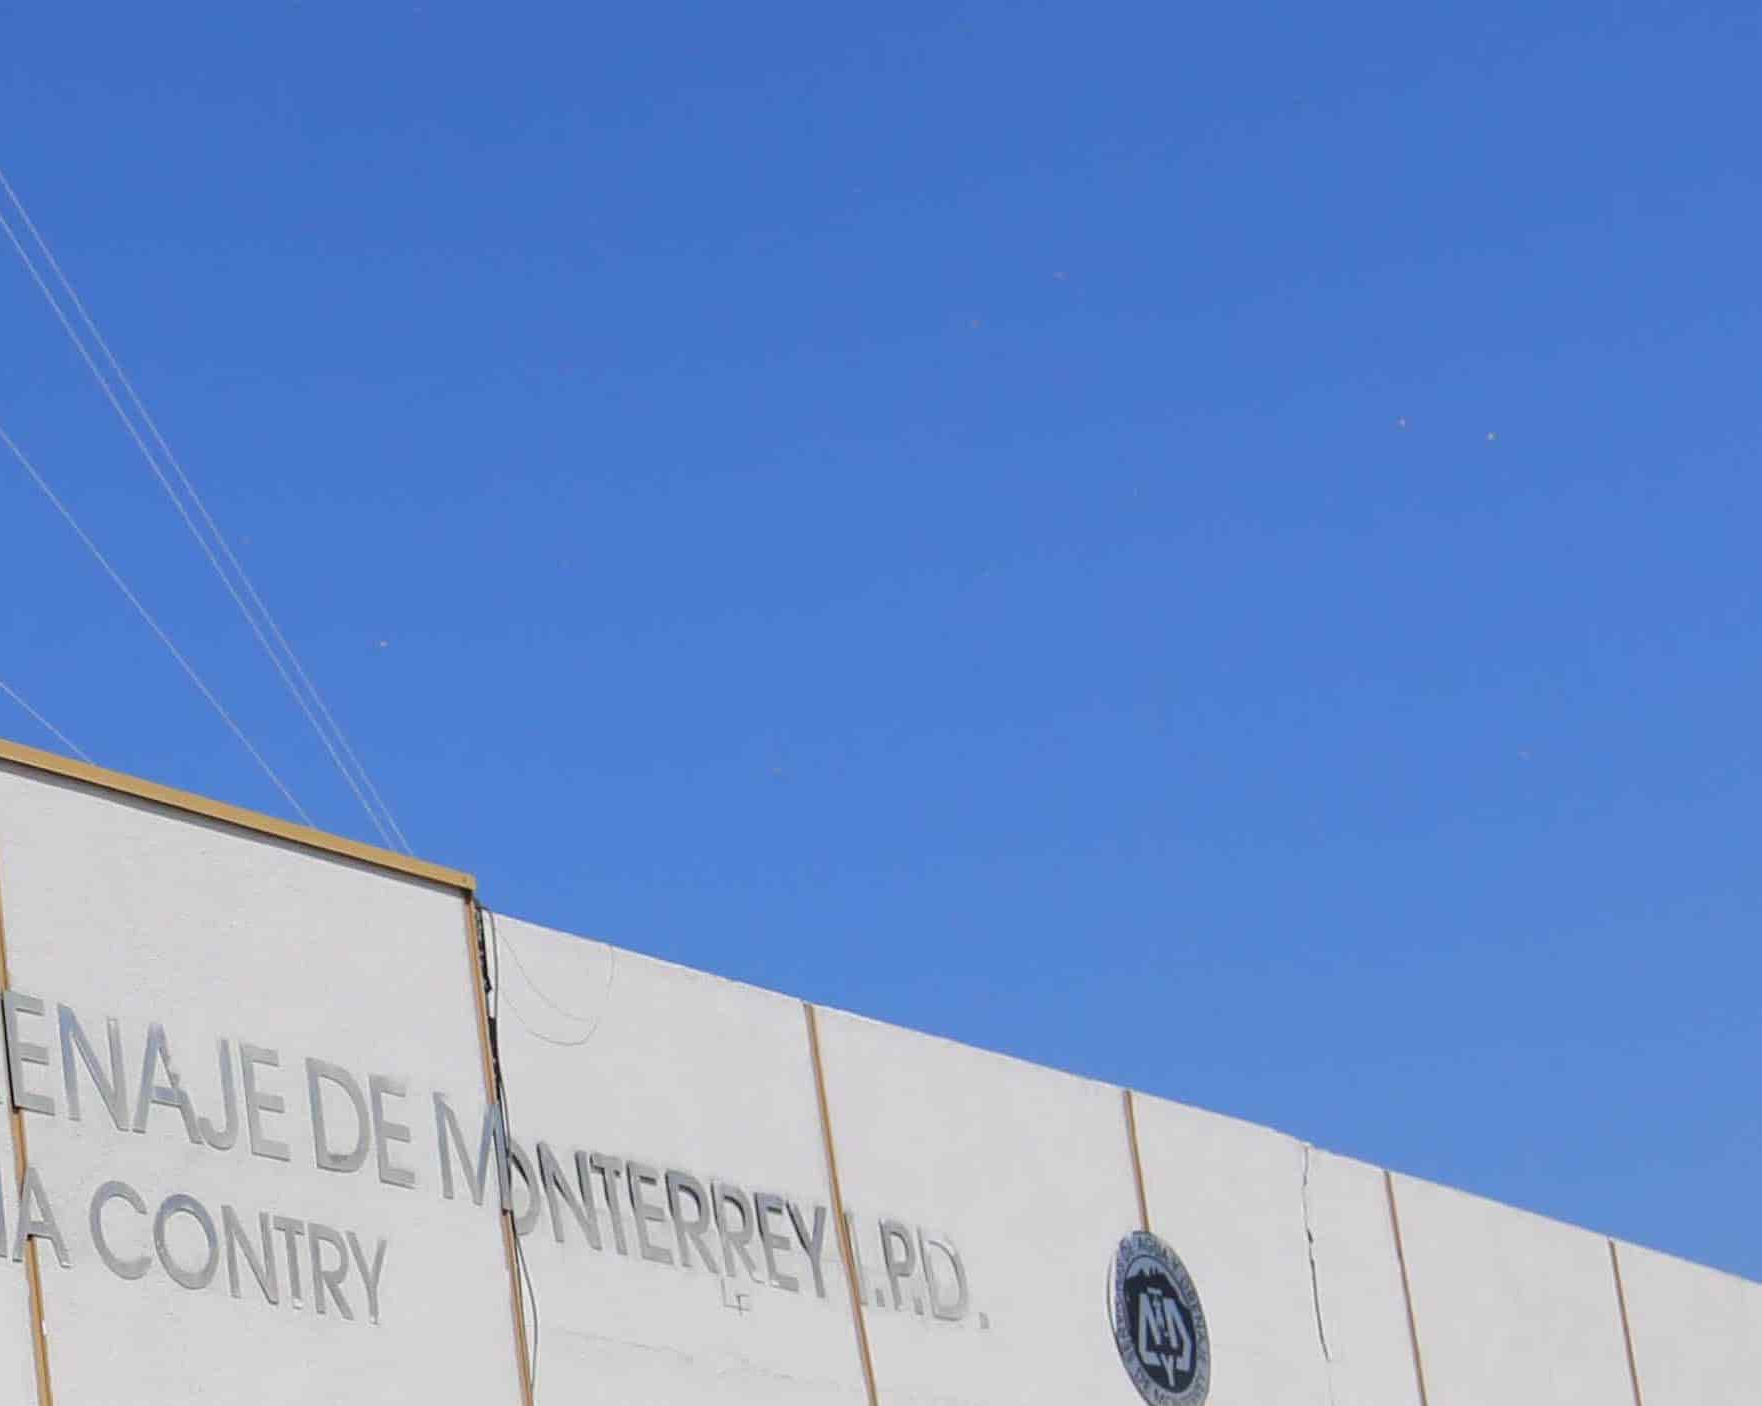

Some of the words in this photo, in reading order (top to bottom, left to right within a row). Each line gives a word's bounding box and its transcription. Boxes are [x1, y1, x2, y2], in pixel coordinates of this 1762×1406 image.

[88, 1179, 388, 1326] CONTRY
[305, 1056, 416, 1190] DE
[432, 1091, 826, 1299] MONTERREY
